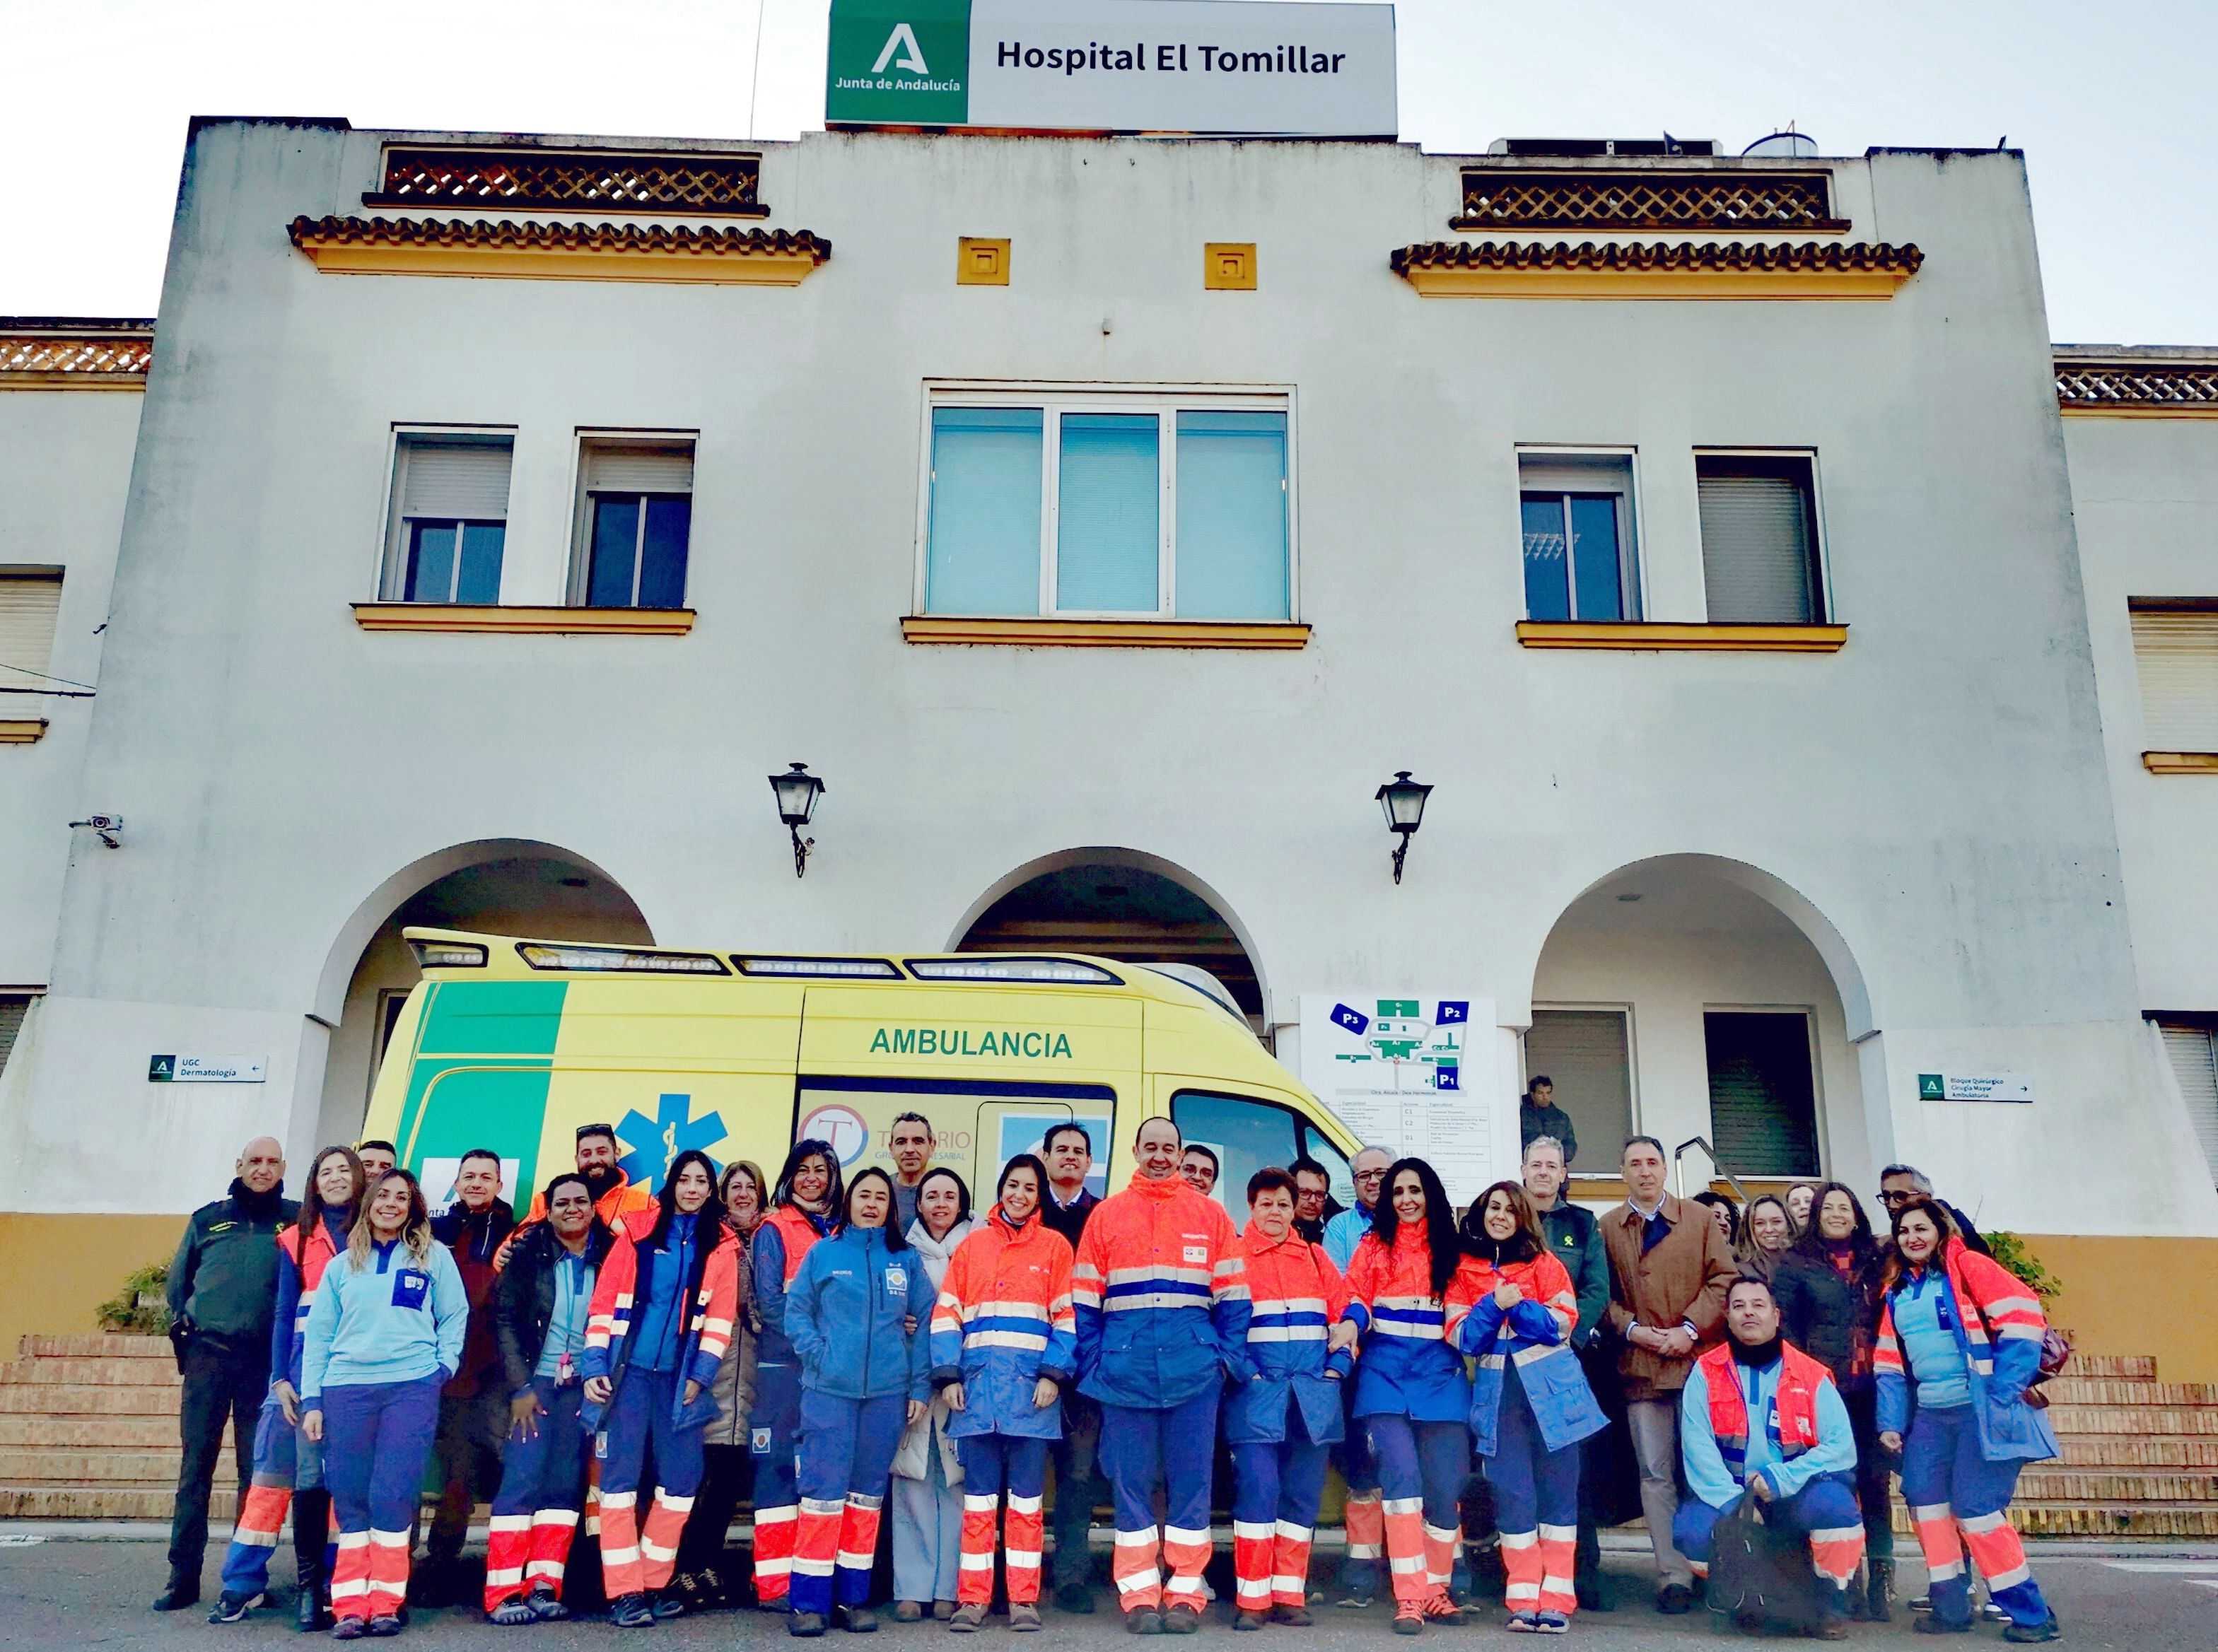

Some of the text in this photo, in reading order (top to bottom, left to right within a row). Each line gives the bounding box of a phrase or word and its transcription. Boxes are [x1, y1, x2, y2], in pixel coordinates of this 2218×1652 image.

[998, 41, 1346, 75] Hospital El Tomillar
[835, 77, 961, 91] Junta de Andalucía
[1343, 1013, 1359, 1024] P3
[1444, 1007, 1461, 1018] P2
[870, 1028, 1073, 1059] AMBULANCIA
[180, 1068, 237, 1078] Dermatología
[1440, 1074, 1454, 1085] P1
[877, 1130, 971, 1149] TRIO
